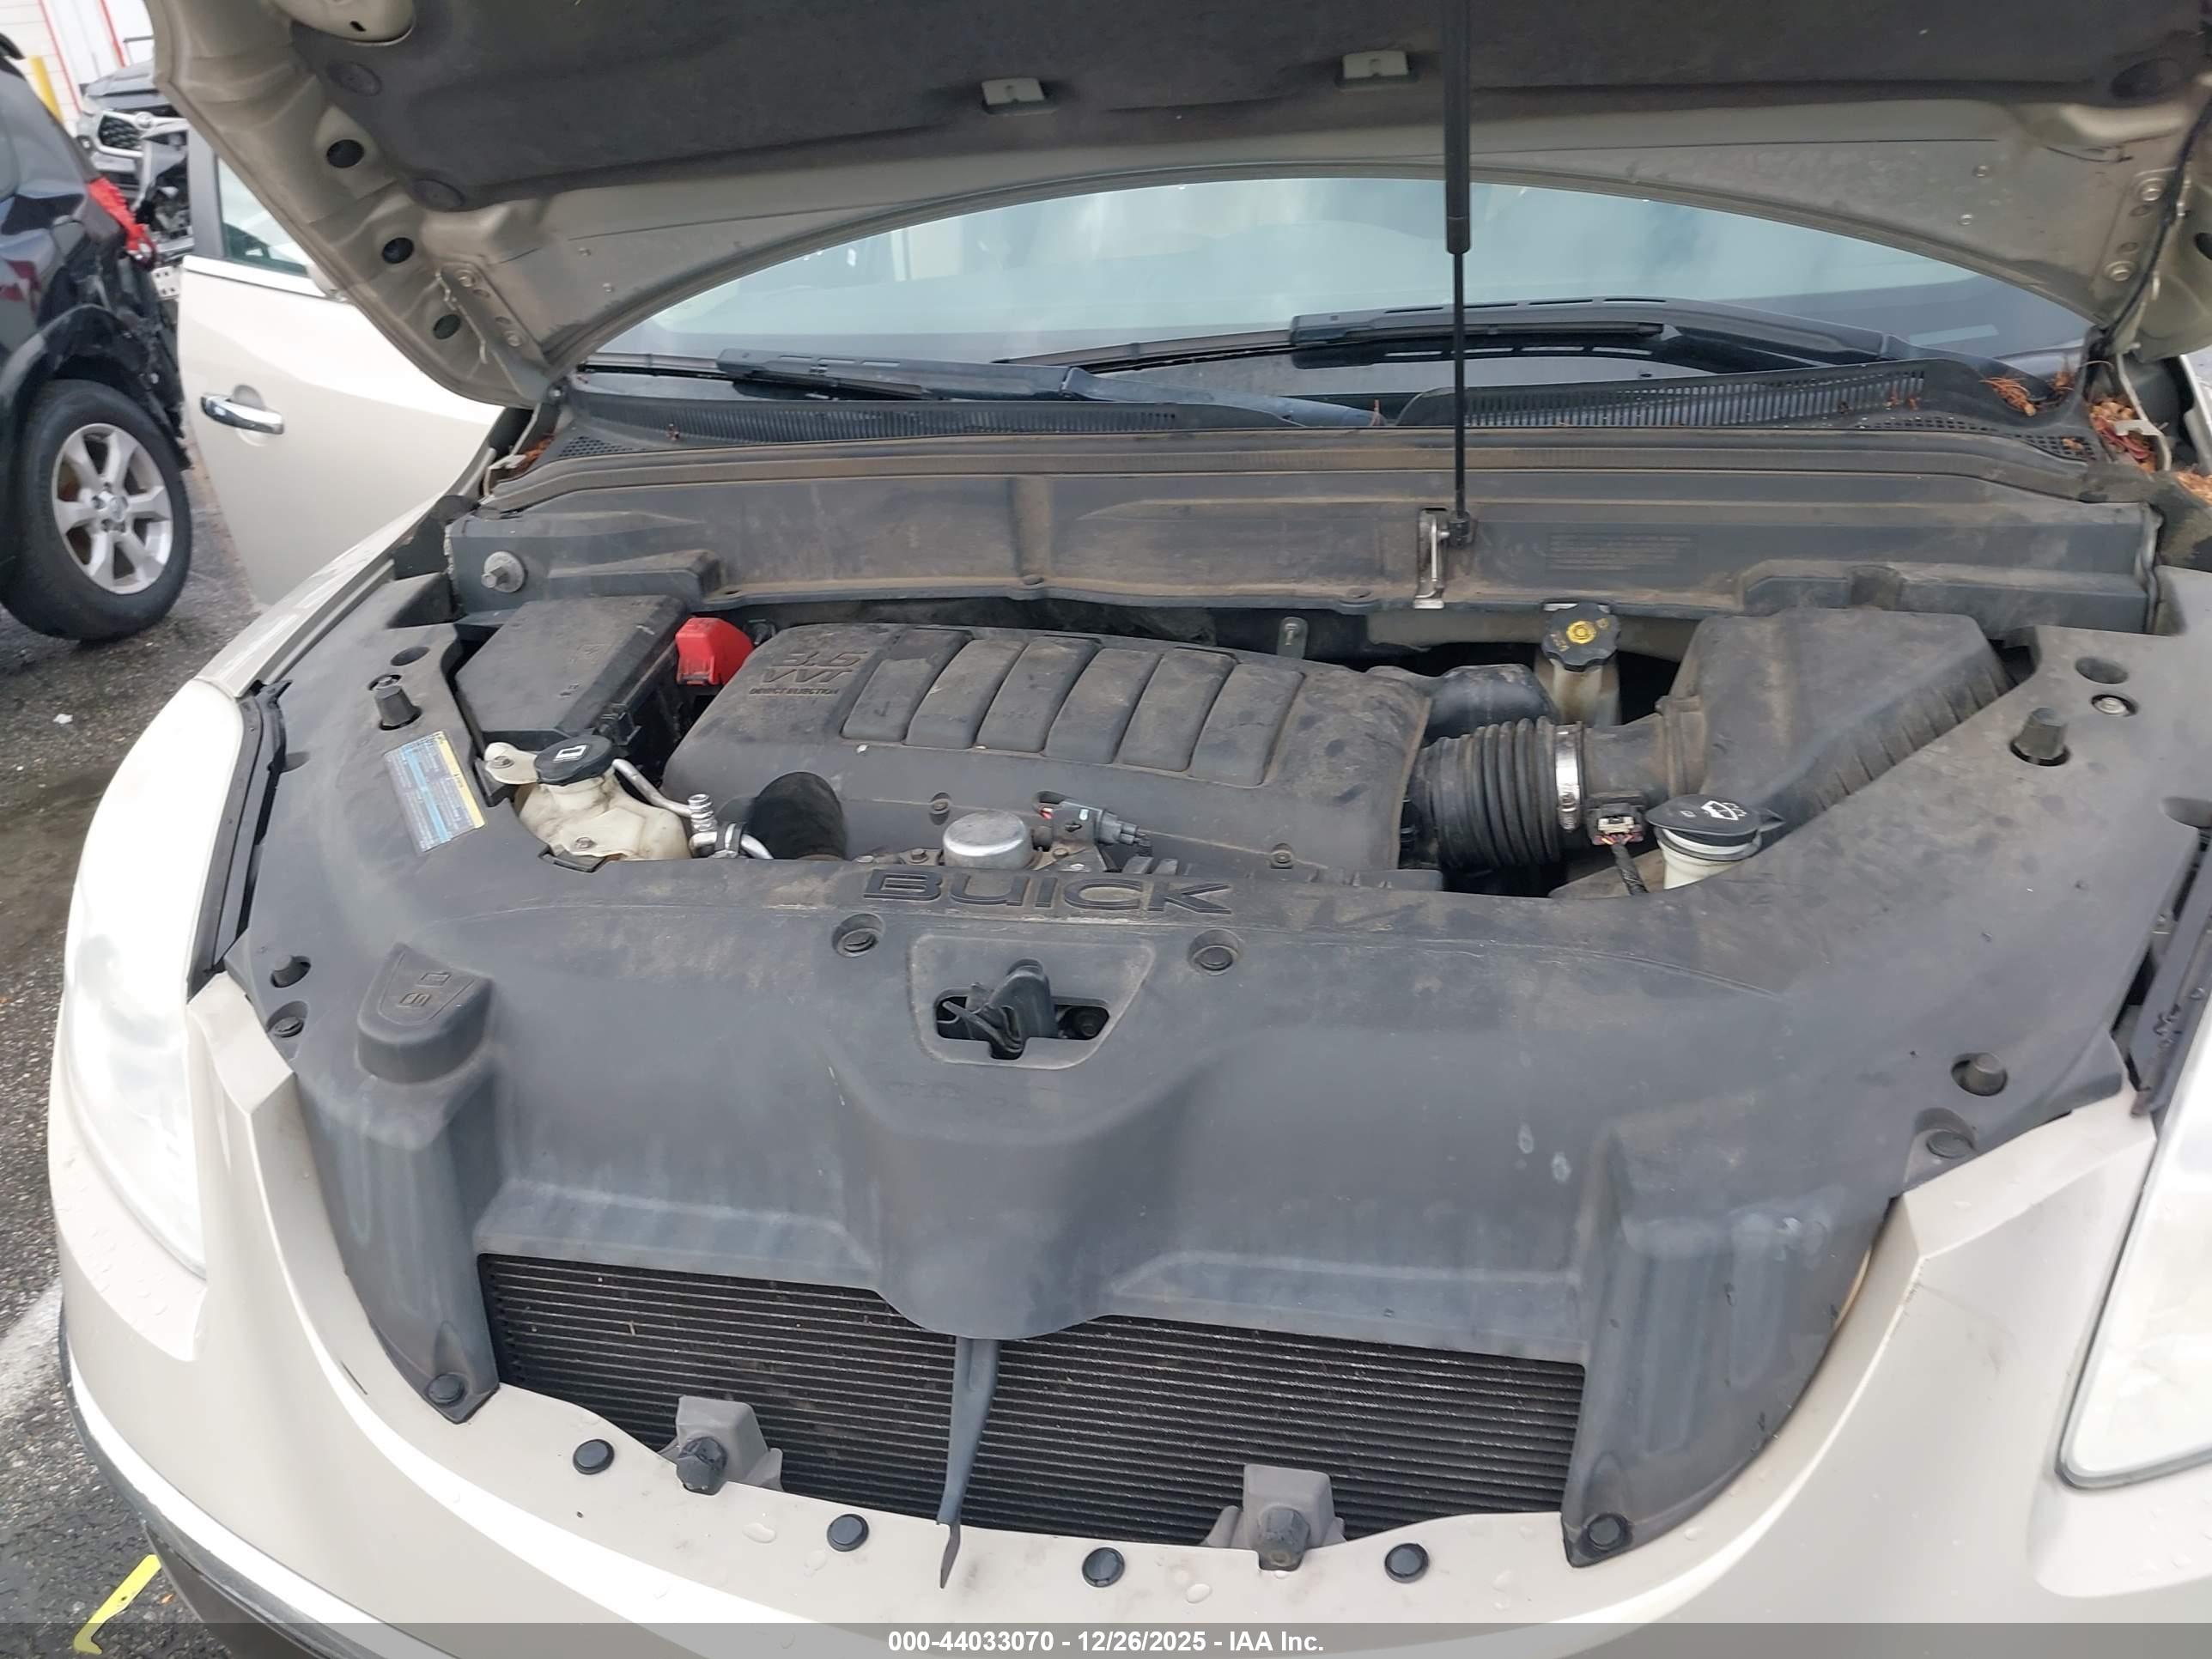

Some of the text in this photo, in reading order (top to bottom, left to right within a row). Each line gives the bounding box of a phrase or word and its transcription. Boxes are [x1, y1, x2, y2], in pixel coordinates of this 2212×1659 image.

[772, 651, 869, 667] 3.6
[762, 669, 854, 684] VVT
[864, 869, 1231, 915] BUICK
